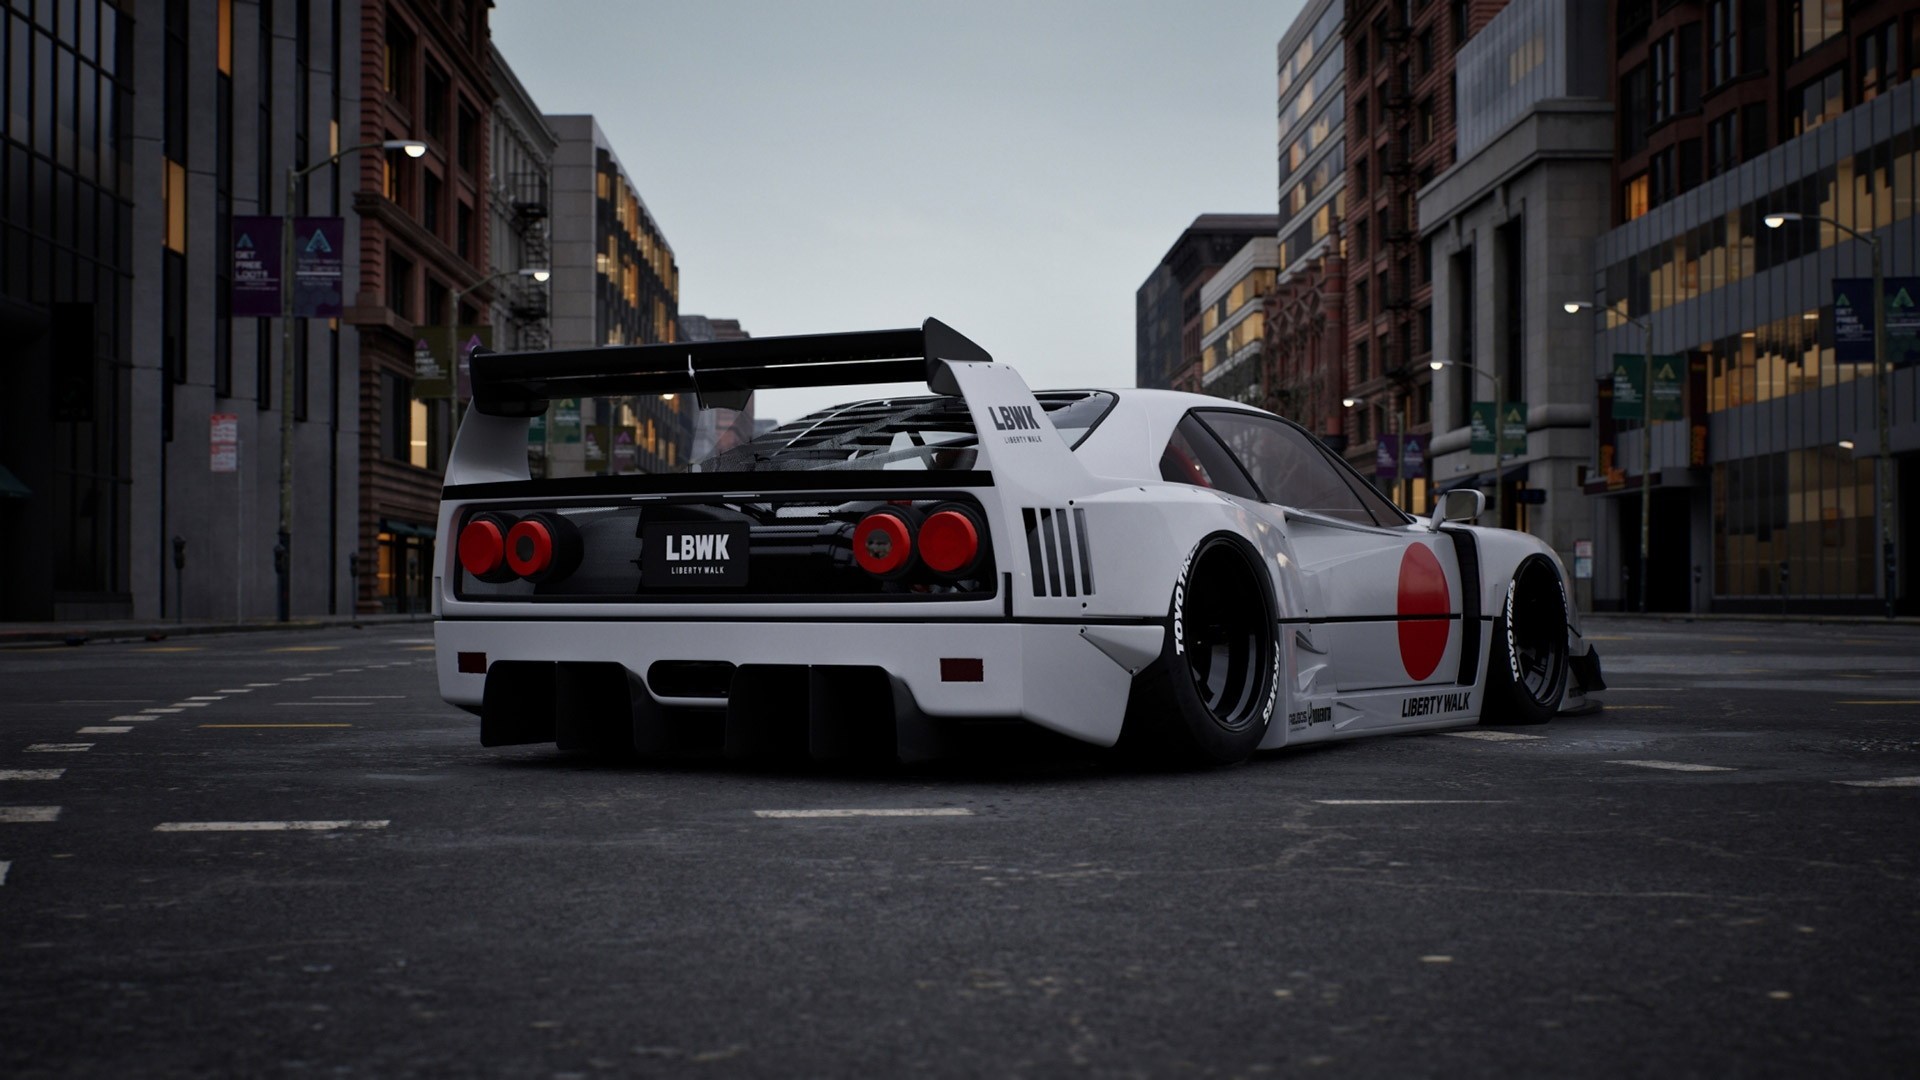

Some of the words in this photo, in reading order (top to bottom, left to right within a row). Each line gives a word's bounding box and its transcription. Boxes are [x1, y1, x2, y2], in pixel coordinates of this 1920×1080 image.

[988, 406, 1040, 430] LBWK
[1004, 436, 1027, 444] LIBERTY
[1027, 435, 1042, 443] WALK
[666, 534, 730, 561] LBWK
[671, 566, 702, 575] LIBERTY
[704, 566, 725, 574] WALK
[1174, 585, 1185, 656] TOYO
[1507, 629, 1520, 683] TOYO
[1401, 695, 1444, 718] LIBERTY
[1443, 692, 1472, 712] WALK
